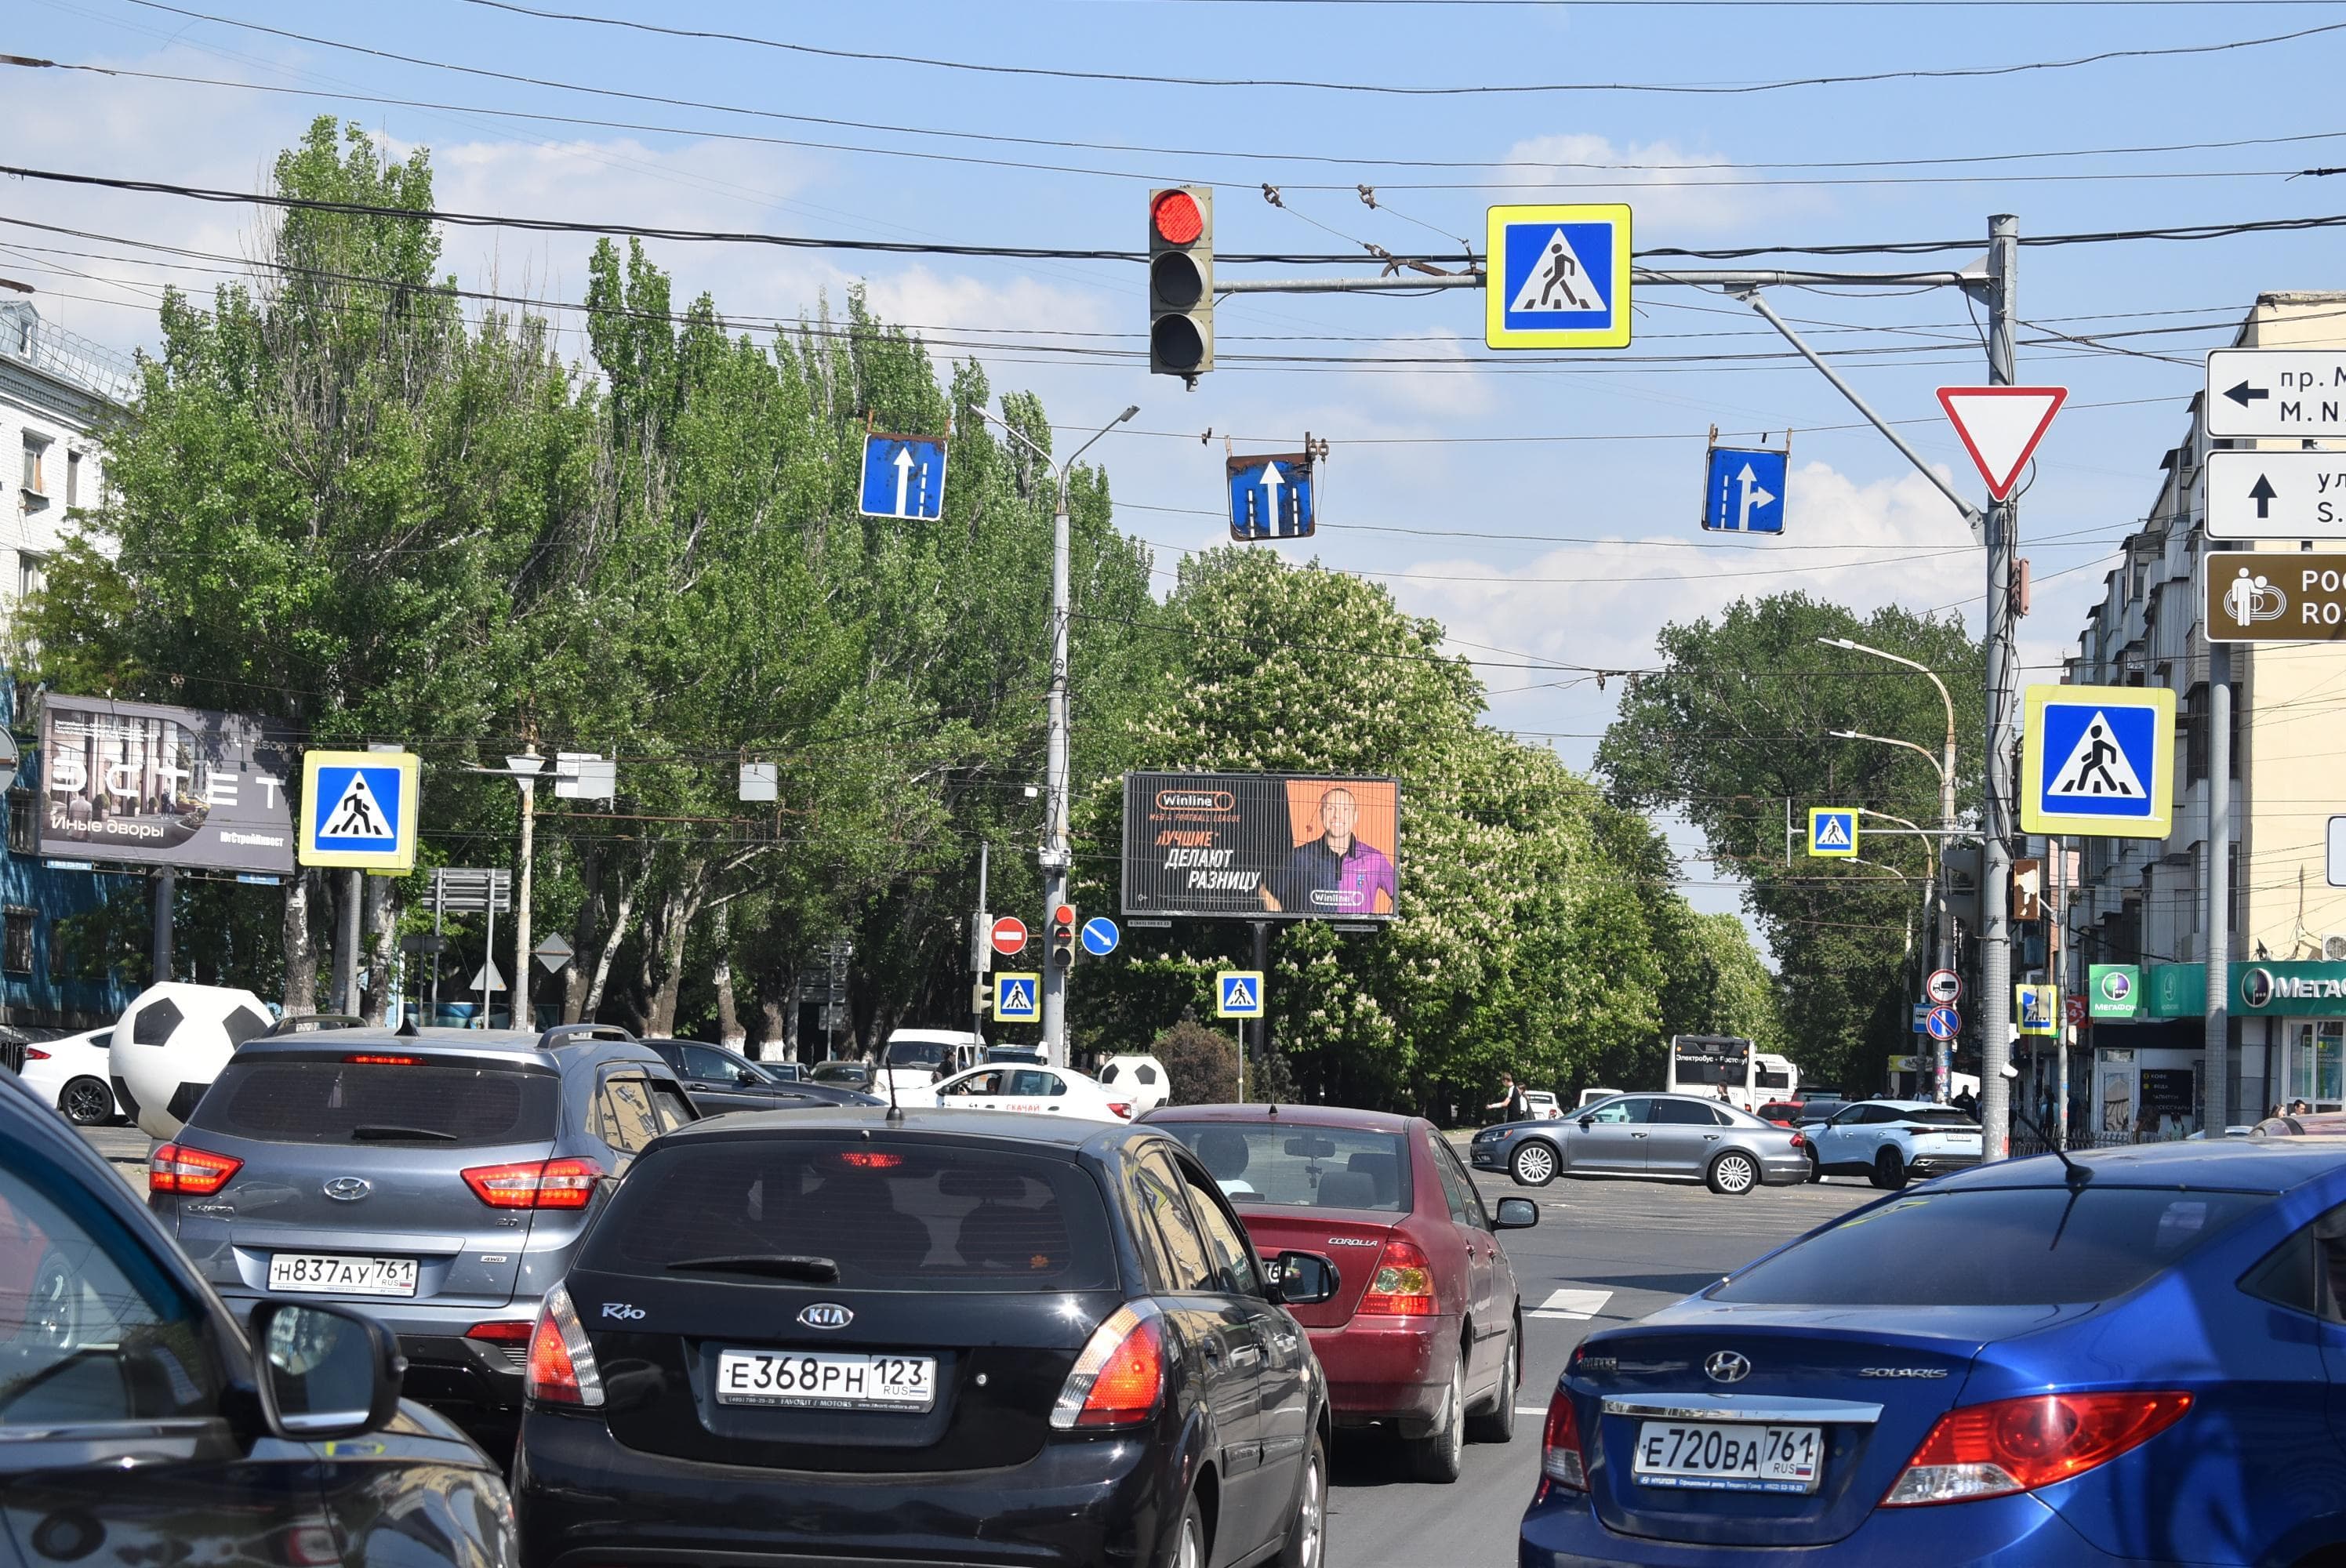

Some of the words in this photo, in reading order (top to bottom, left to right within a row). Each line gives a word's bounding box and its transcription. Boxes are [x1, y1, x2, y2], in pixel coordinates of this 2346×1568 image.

[2281, 372, 2324, 392] пр.
[2302, 570, 2346, 592] РО
[2302, 602, 2346, 624] RO
[1163, 794, 1212, 806] Winline
[51, 815, 103, 833] Иные
[107, 820, 164, 839] дворы
[1164, 848, 1233, 869] ДЕЛАЮТ
[1188, 870, 1261, 892] РАЗНИЦУ
[2275, 977, 2346, 998] МЕГА
[1676, 1054, 1714, 1064] Электробус
[1006, 1103, 1040, 1112] СКАЧАЙ
[1327, 1237, 1378, 1247] COROLLA
[278, 1258, 370, 1283] Н837АУ
[376, 1261, 412, 1279] 761
[601, 1303, 645, 1320] Rio
[808, 1308, 844, 1323] KIA
[731, 1355, 863, 1392] Е368РН
[873, 1359, 924, 1385] 123
[1858, 1367, 1948, 1378] SOLARIS
[883, 1385, 909, 1396] RUS
[781, 1398, 812, 1406] FAVORIT
[820, 1399, 852, 1408] MOTORS
[1645, 1428, 1757, 1472] Е720ВА
[1767, 1430, 1813, 1463] 761
[1773, 1463, 1795, 1475] RUS
